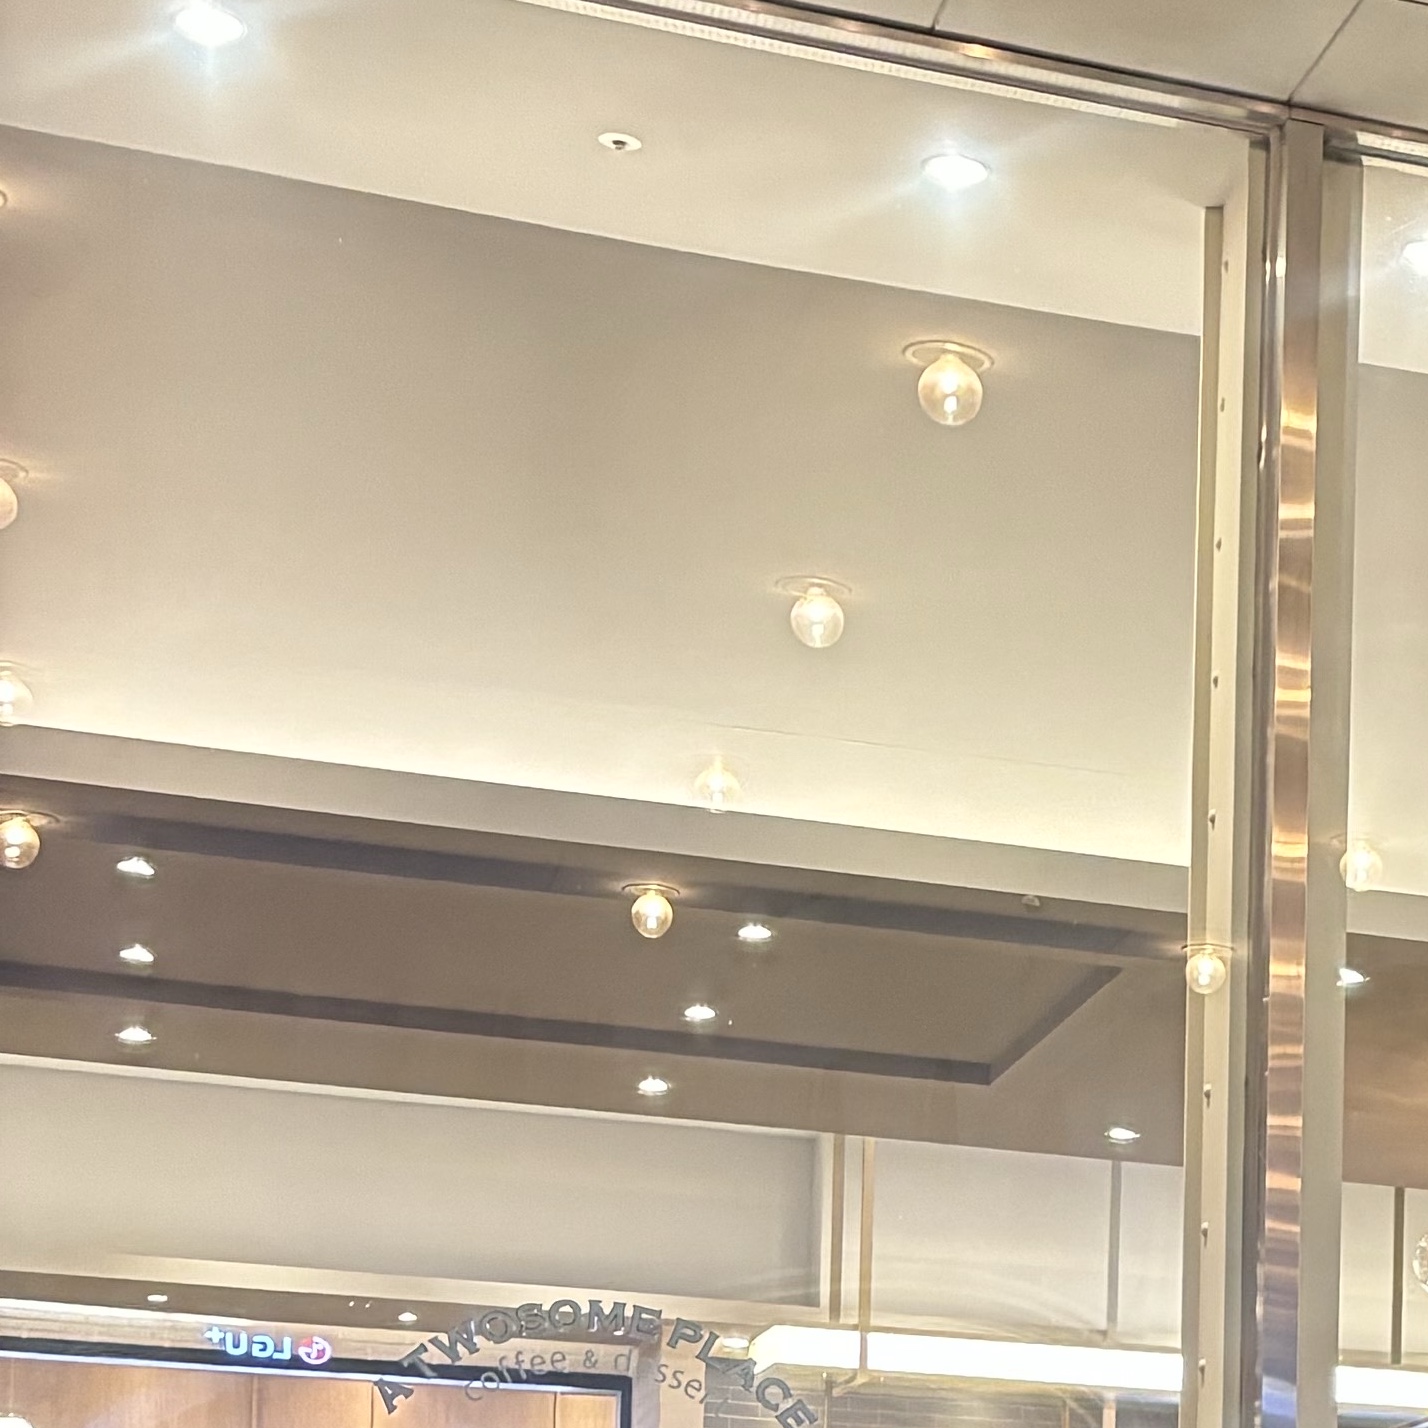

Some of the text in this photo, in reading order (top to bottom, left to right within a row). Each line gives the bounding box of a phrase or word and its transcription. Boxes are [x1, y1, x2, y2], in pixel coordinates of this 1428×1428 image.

[371, 1377, 415, 1415] A
[397, 1299, 663, 1379] TWOSOME
[463, 1350, 568, 1402] coffee
